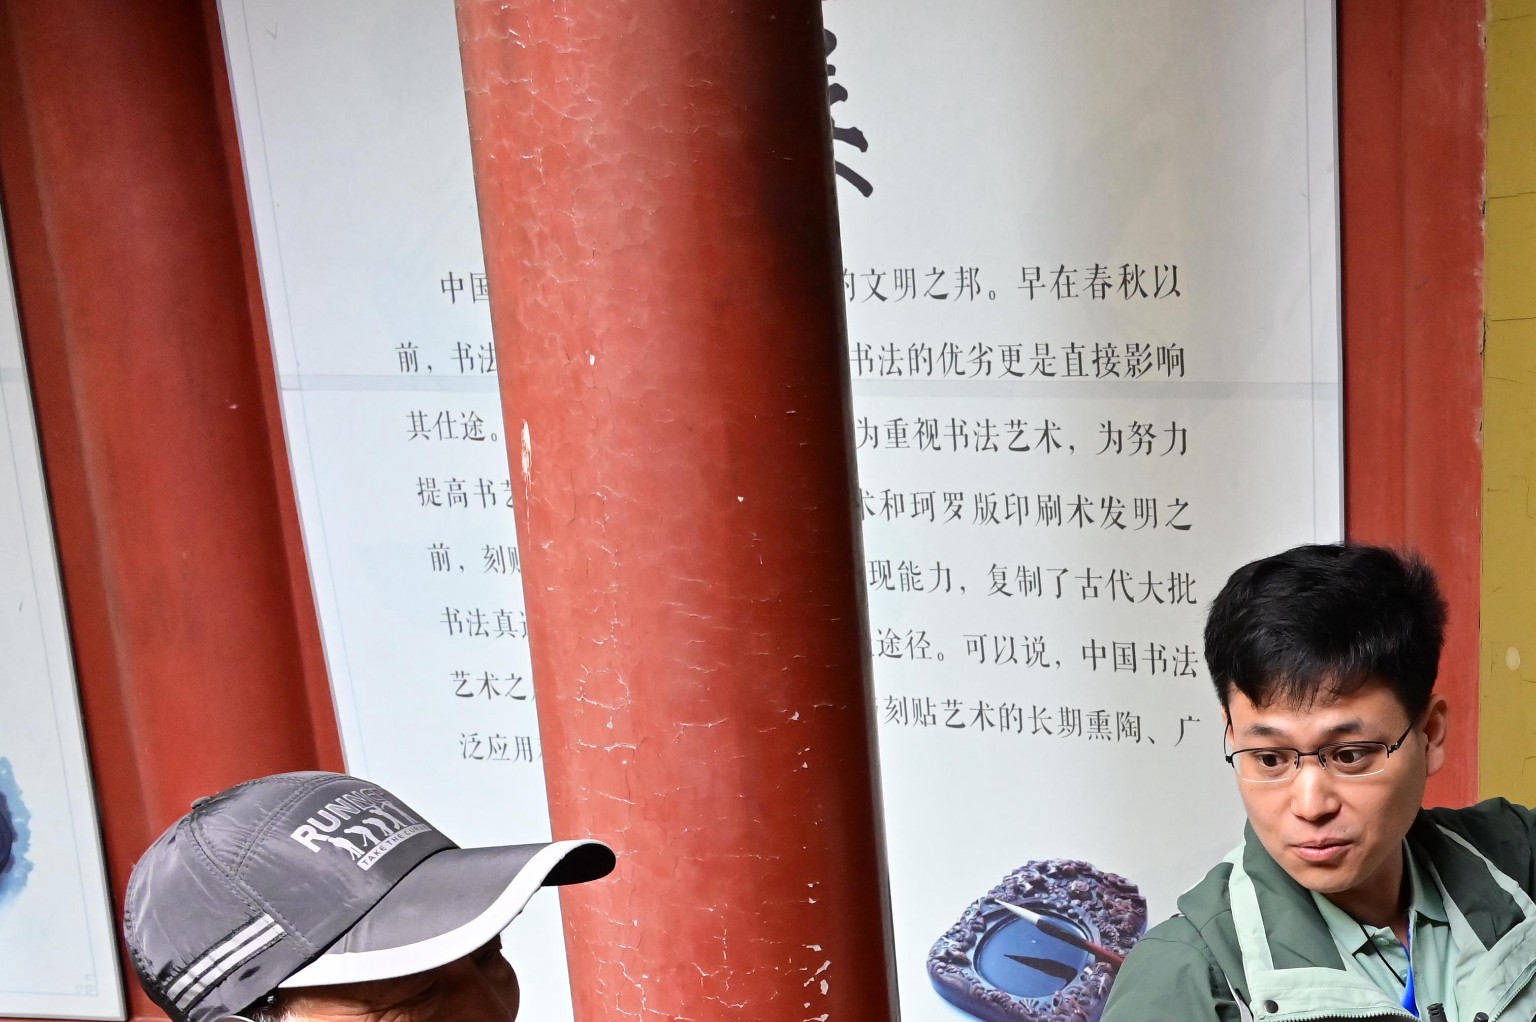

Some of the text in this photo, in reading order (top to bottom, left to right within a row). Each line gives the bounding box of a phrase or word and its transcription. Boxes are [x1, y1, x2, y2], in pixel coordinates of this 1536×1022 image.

[440, 271, 489, 304] 中国
[850, 341, 1185, 379] 书法的优劣更是直接影响
[405, 410, 1187, 457] 其仕途。 为重视书法艺术，为努力
[867, 559, 1197, 604] 现能力，复制了古代大批
[440, 606, 1198, 678] 书法真 途径。可以说，中国书法
[450, 670, 1200, 747] 艺术之 刻贴艺术的长期熏陶、广
[459, 732, 542, 764] 泛应用
